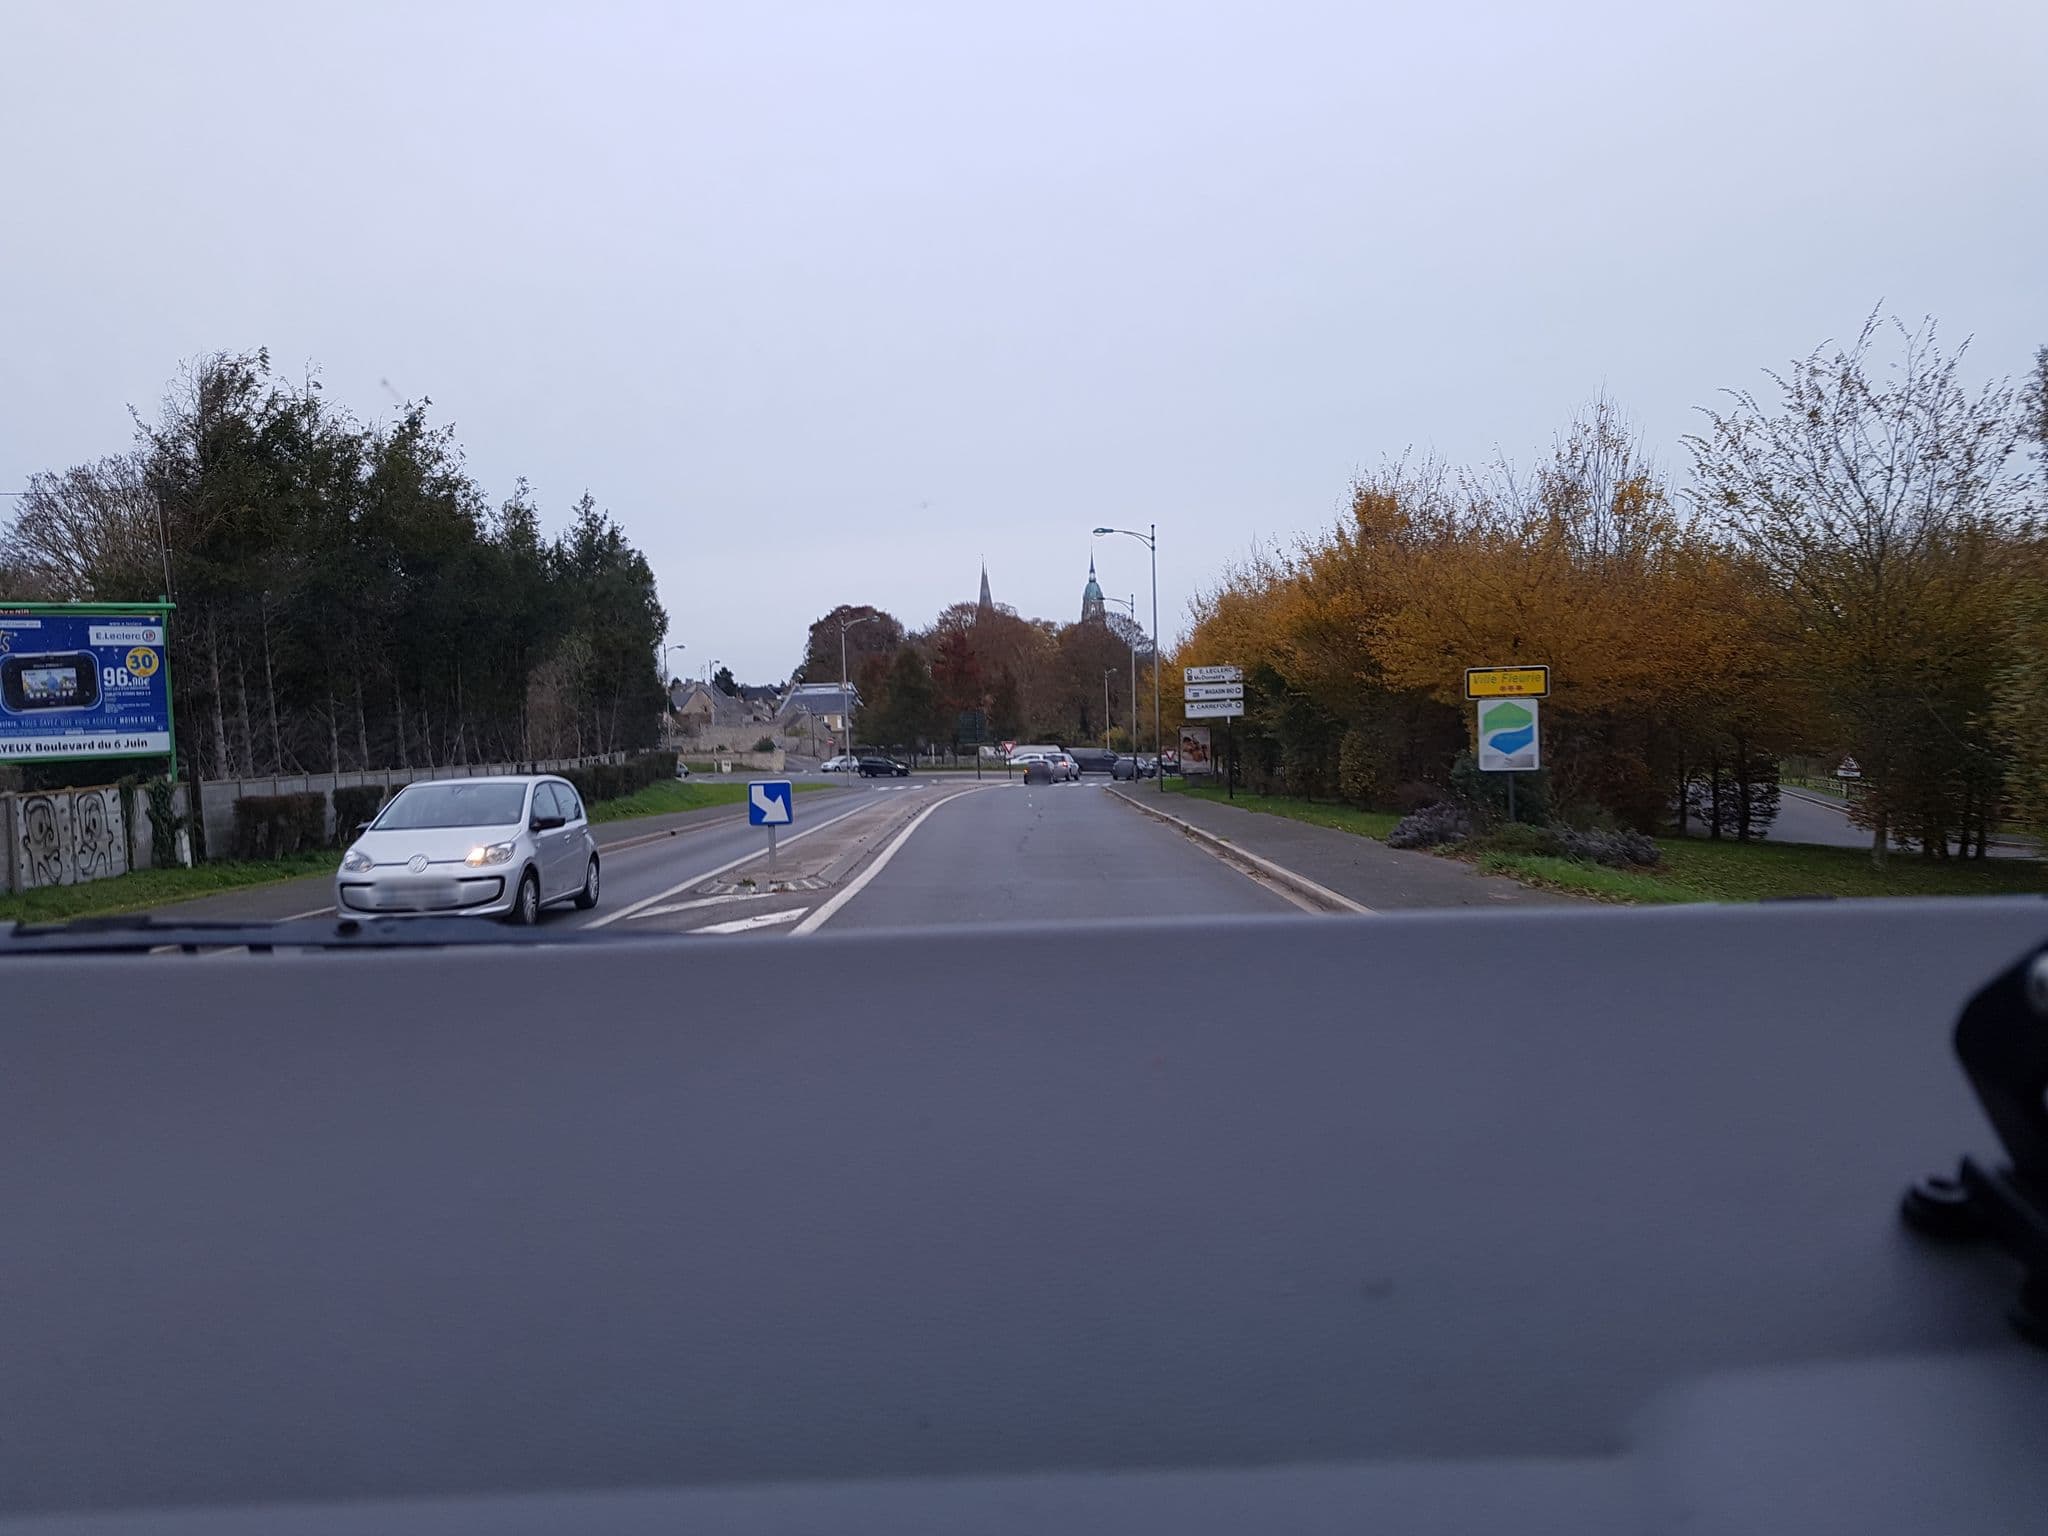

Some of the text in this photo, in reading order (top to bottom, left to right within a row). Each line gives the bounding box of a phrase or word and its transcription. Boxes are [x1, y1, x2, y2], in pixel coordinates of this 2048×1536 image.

[0, 738, 148, 753] YEUX Boulevard du 6 Juin
